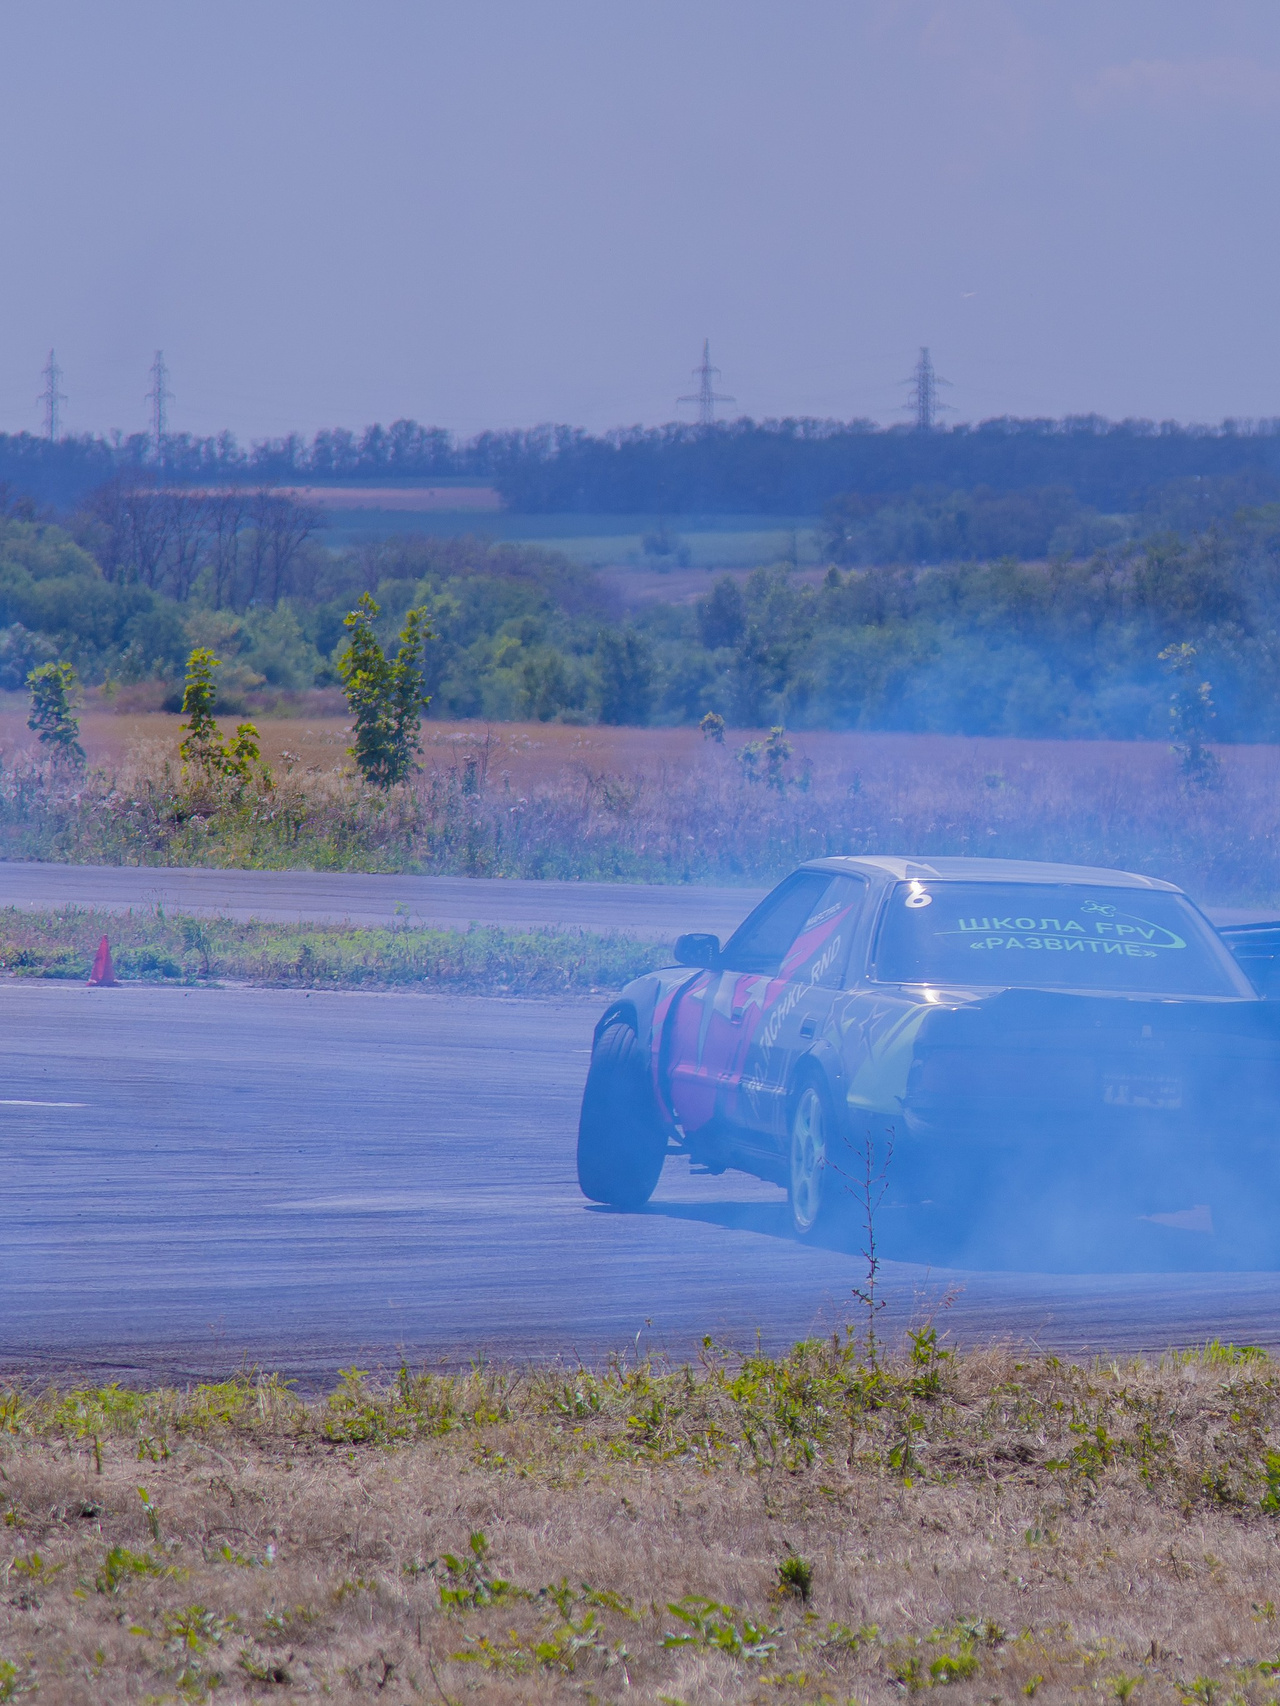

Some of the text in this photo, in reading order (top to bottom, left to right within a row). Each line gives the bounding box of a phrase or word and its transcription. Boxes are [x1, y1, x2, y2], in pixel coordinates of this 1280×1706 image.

[904, 885, 933, 908] 6
[958, 917, 1159, 940] ШКОЛА FPV
[969, 937, 1158, 957] «РАЗВИТИЕ»
